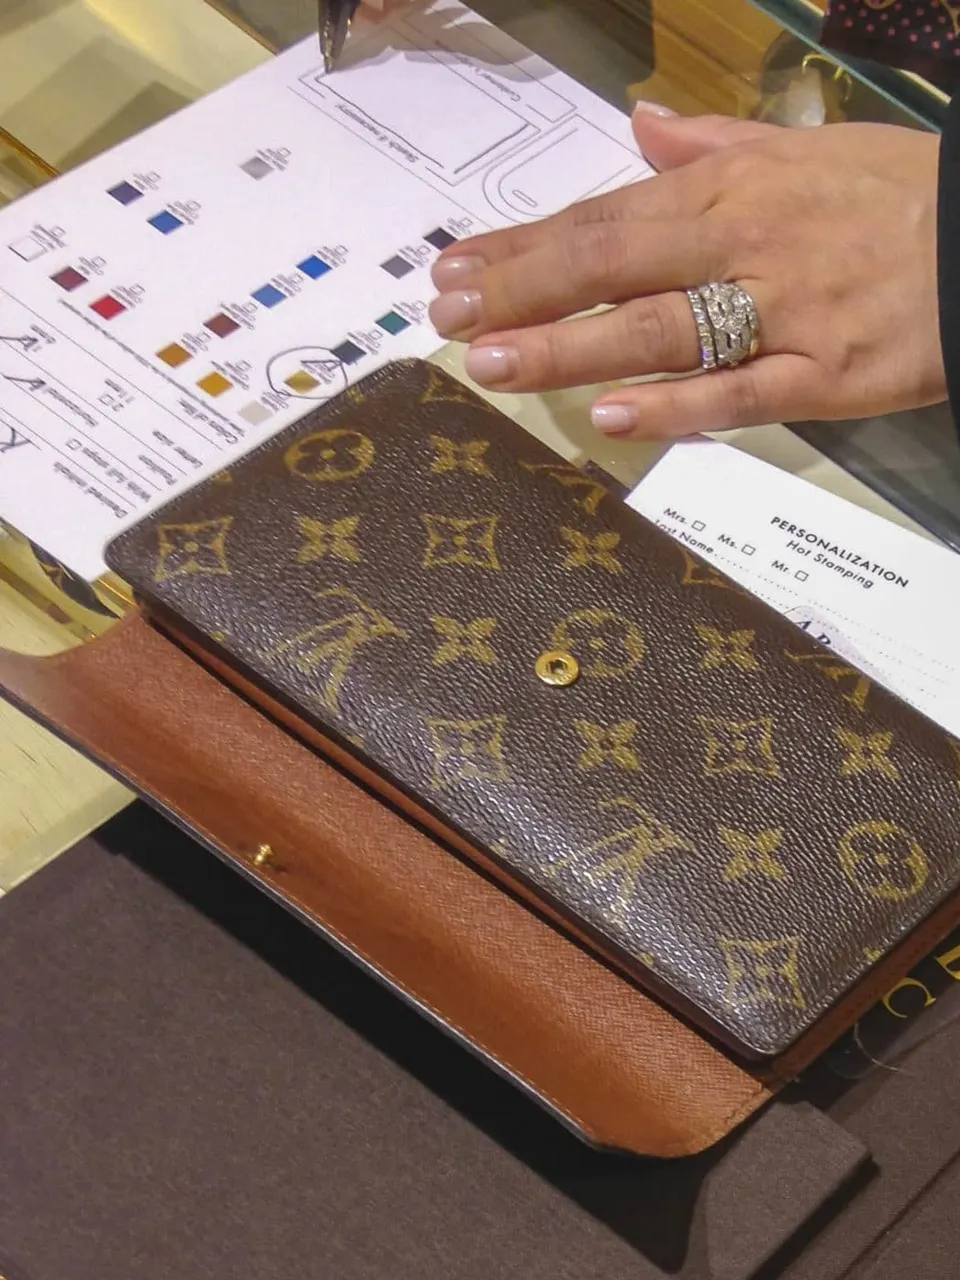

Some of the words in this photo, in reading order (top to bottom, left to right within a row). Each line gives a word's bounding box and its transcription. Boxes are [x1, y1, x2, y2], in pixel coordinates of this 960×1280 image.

[662, 507, 689, 526] Mrs.
[677, 531, 715, 555] Name
[717, 532, 739, 551] Ms.
[769, 515, 910, 589] PERSONALIZATION
[786, 539, 812, 558] Hot
[812, 552, 876, 591] Stamping
